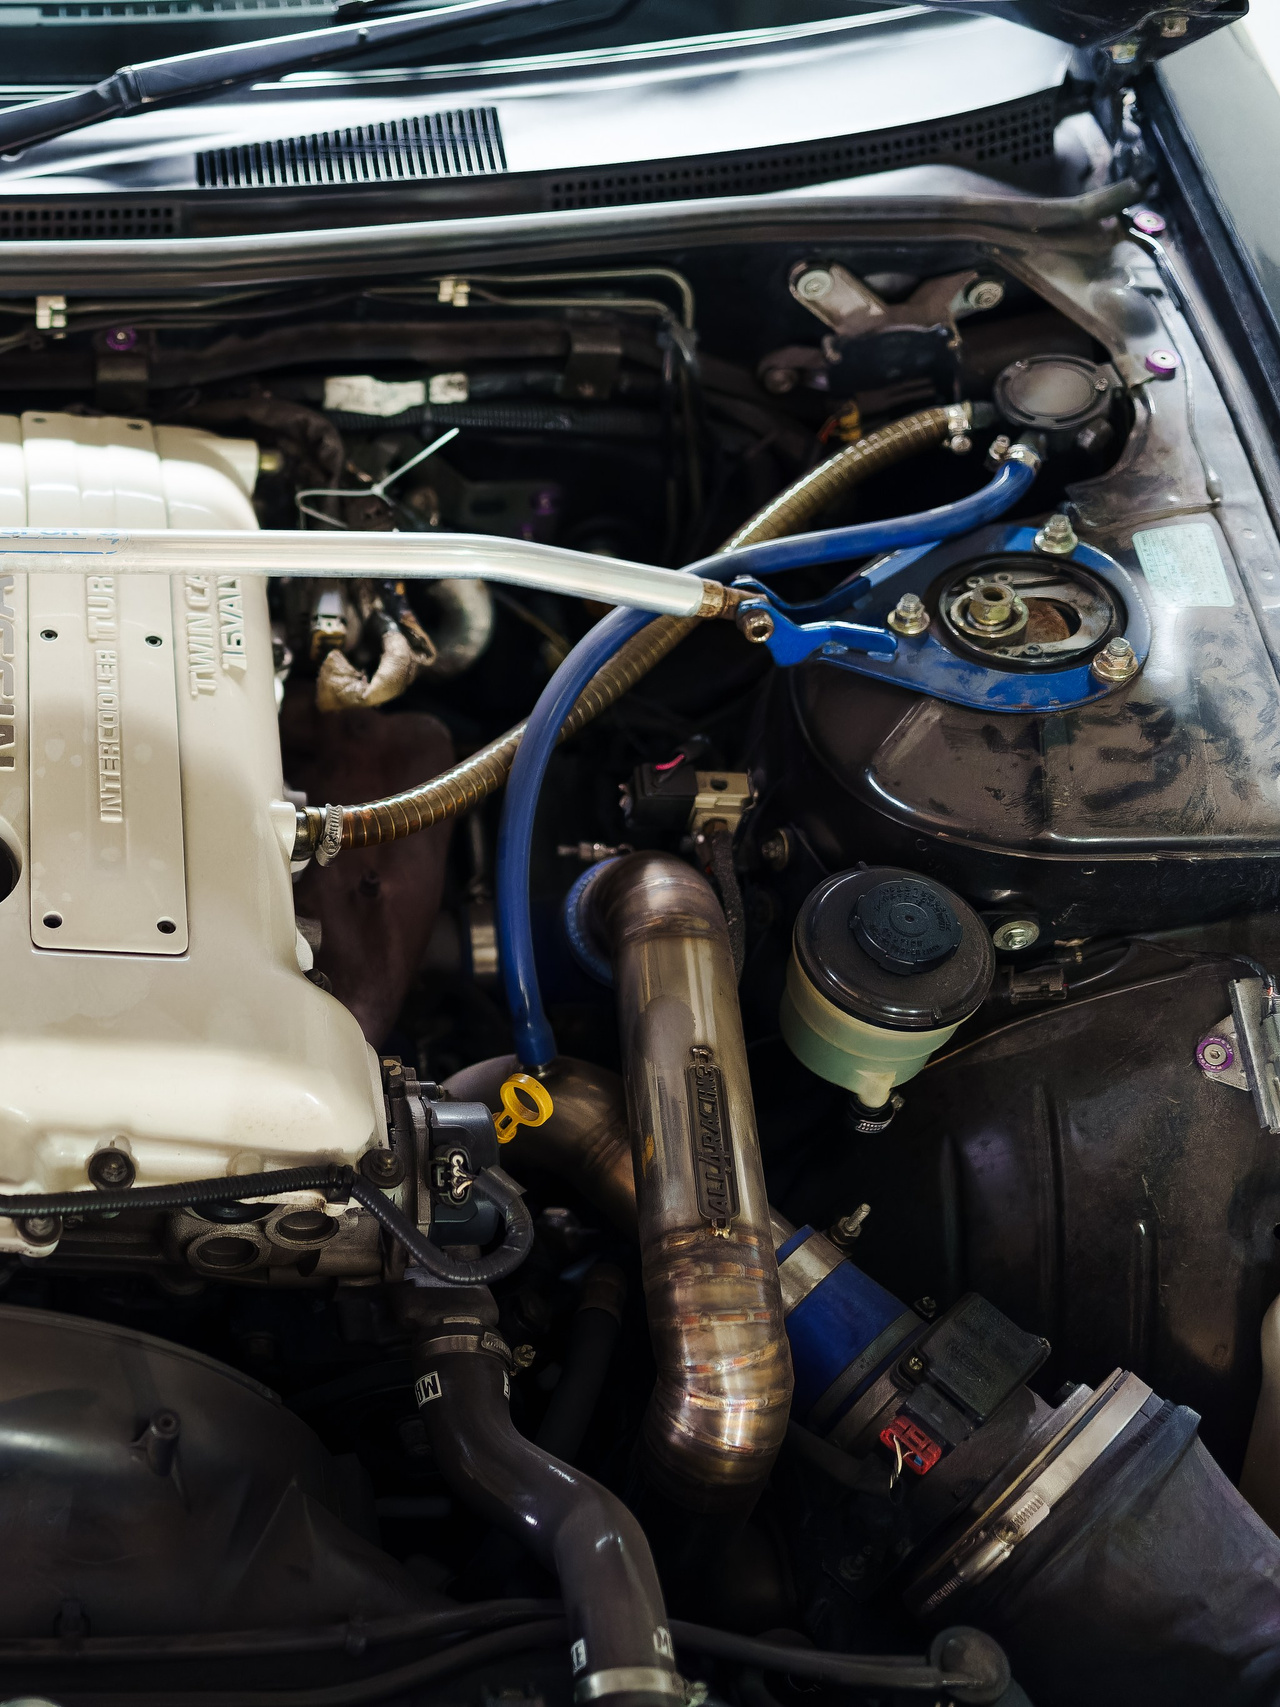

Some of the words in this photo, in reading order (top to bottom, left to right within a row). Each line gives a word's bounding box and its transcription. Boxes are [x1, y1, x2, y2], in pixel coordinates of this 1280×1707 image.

[86, 575, 118, 642] TUR
[186, 611, 217, 697] TWIN
[96, 649, 123, 823] INTERCOOLER
